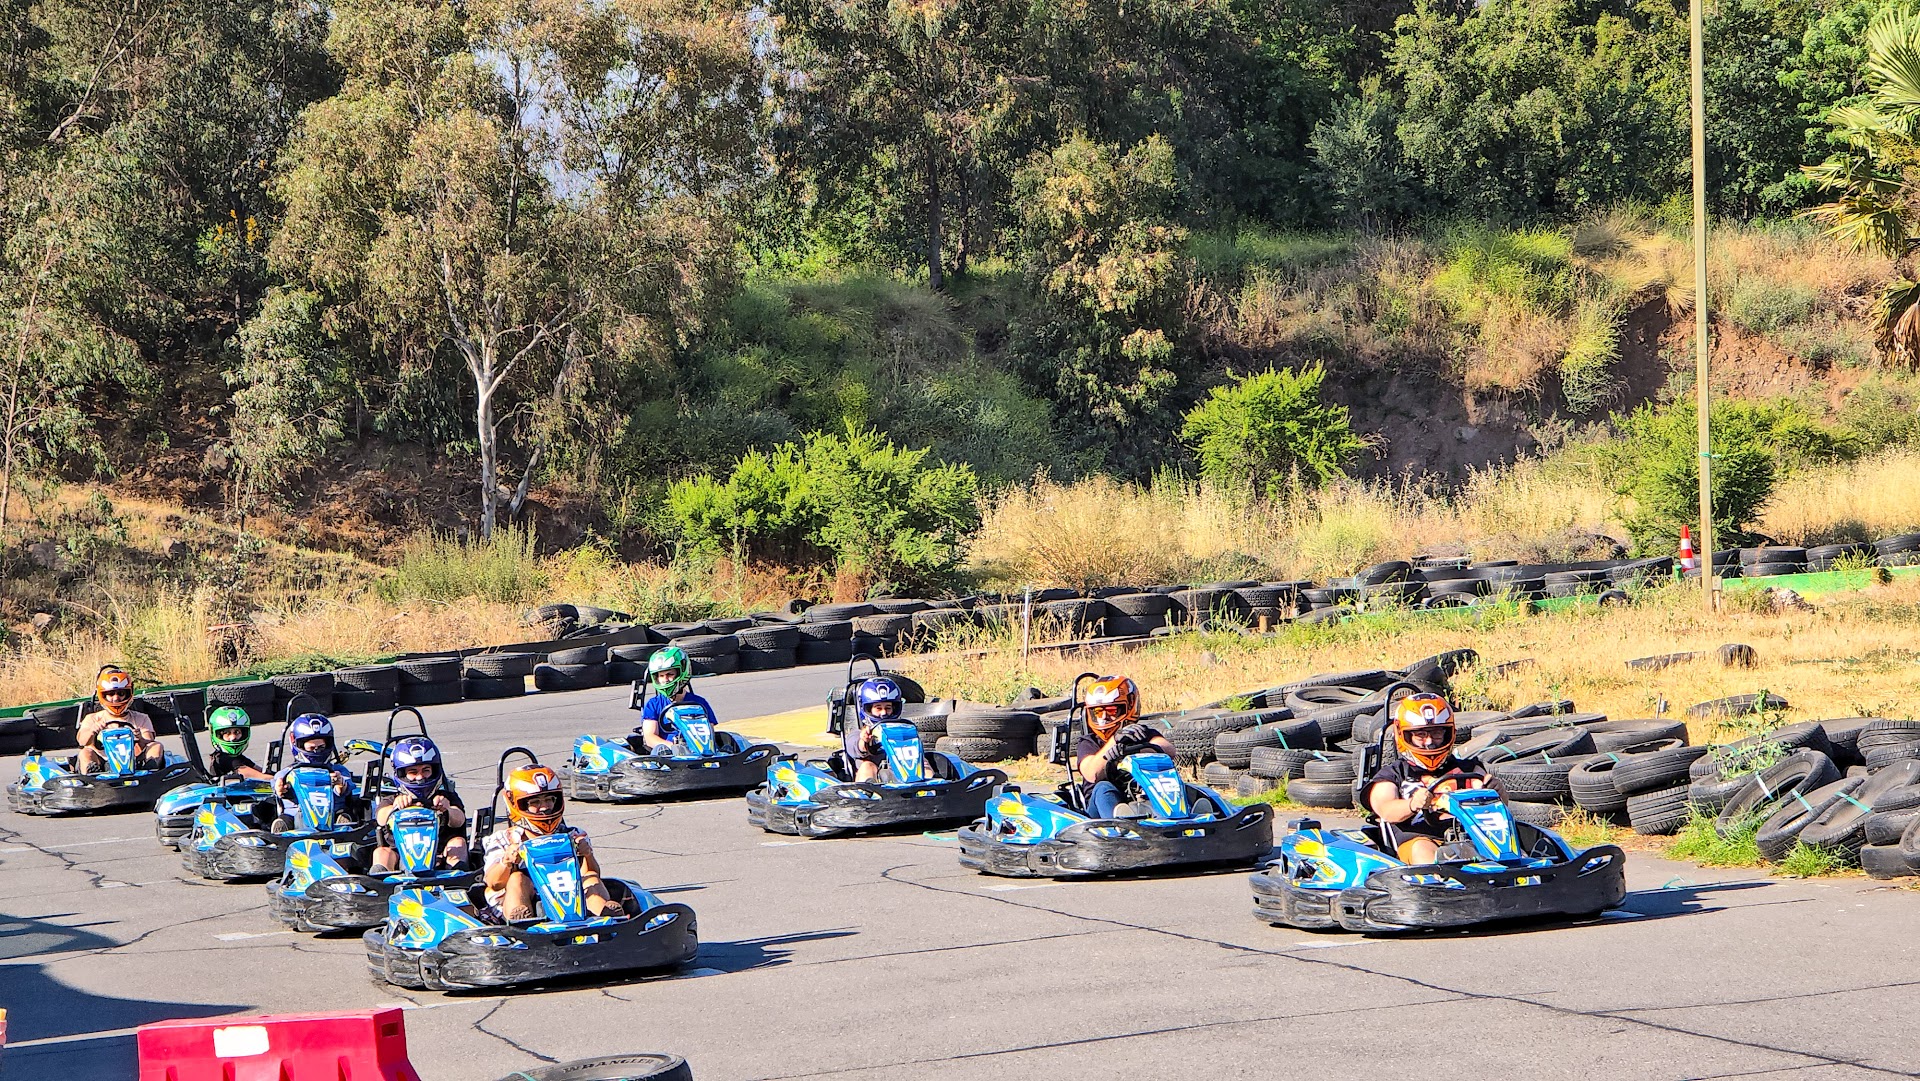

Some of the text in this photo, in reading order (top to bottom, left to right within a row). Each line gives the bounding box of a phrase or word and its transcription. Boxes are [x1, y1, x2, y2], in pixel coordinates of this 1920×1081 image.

[687, 723, 711, 737] 13
[114, 743, 127, 756] 1
[893, 746, 920, 761] 10
[1150, 777, 1181, 793] 12
[308, 792, 329, 807] 6
[1473, 812, 1509, 831] 3
[403, 832, 431, 850] 14
[546, 871, 576, 892] 8
[563, 1057, 655, 1074] WRANGLER
